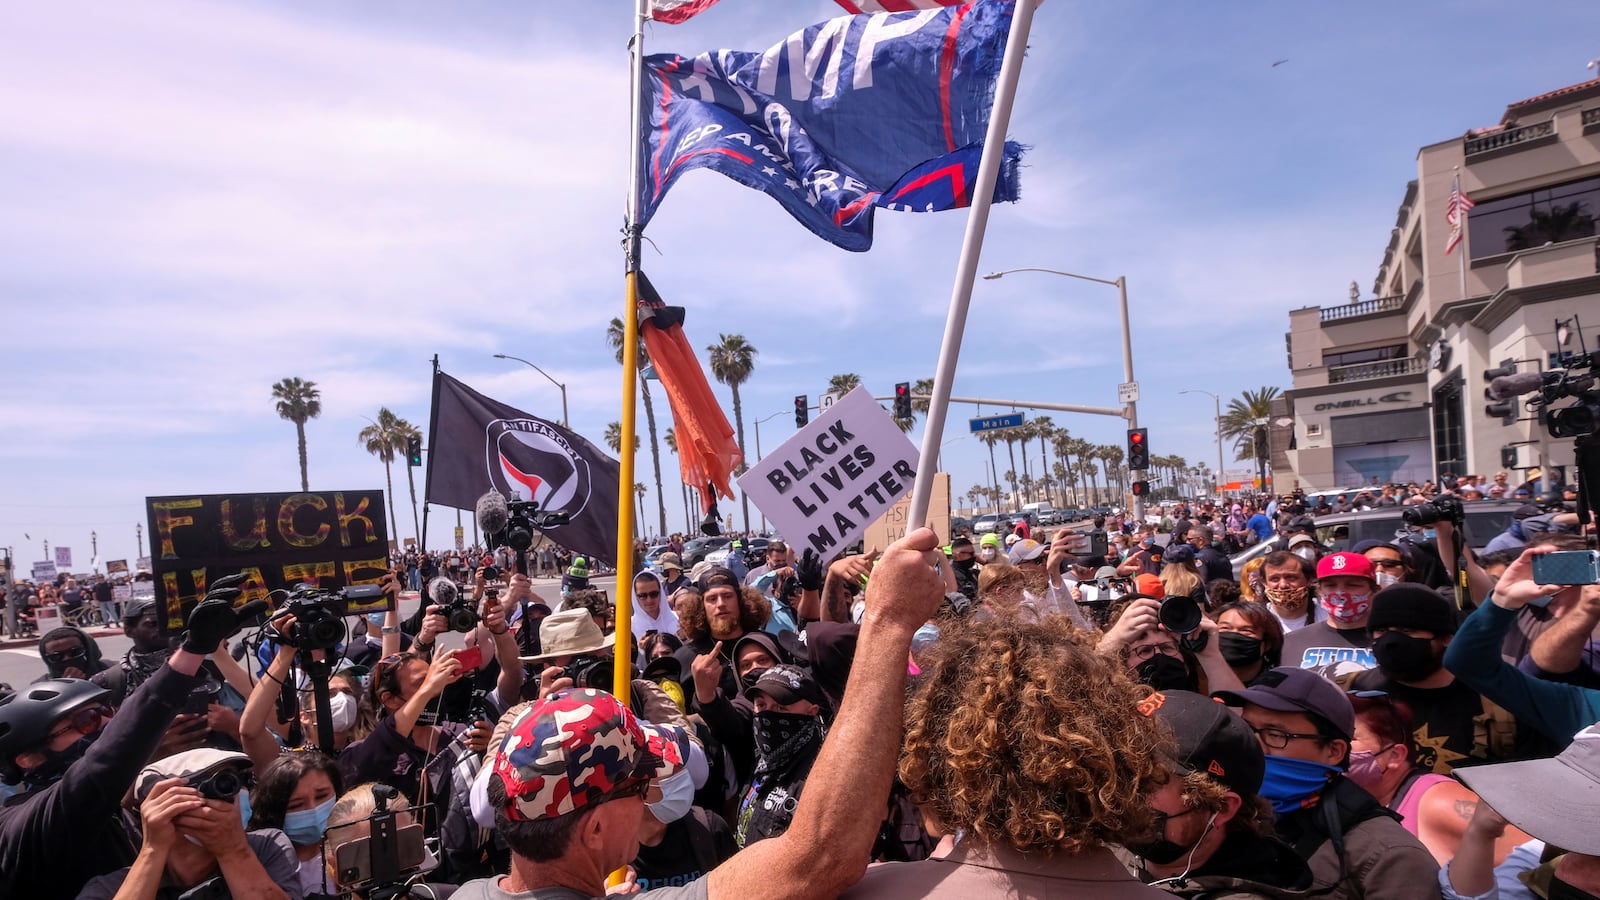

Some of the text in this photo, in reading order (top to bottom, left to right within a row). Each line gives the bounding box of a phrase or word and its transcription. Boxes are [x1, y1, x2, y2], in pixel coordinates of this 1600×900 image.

[502, 421, 583, 461] ANTIFASCIST
[982, 418, 1011, 429] Main
[766, 419, 855, 495] BLACK
[792, 444, 876, 518] LIVES
[152, 492, 378, 560] FUCK
[807, 459, 917, 554] MATTER
[1331, 555, 1347, 570] B
[1300, 647, 1378, 670] STON
